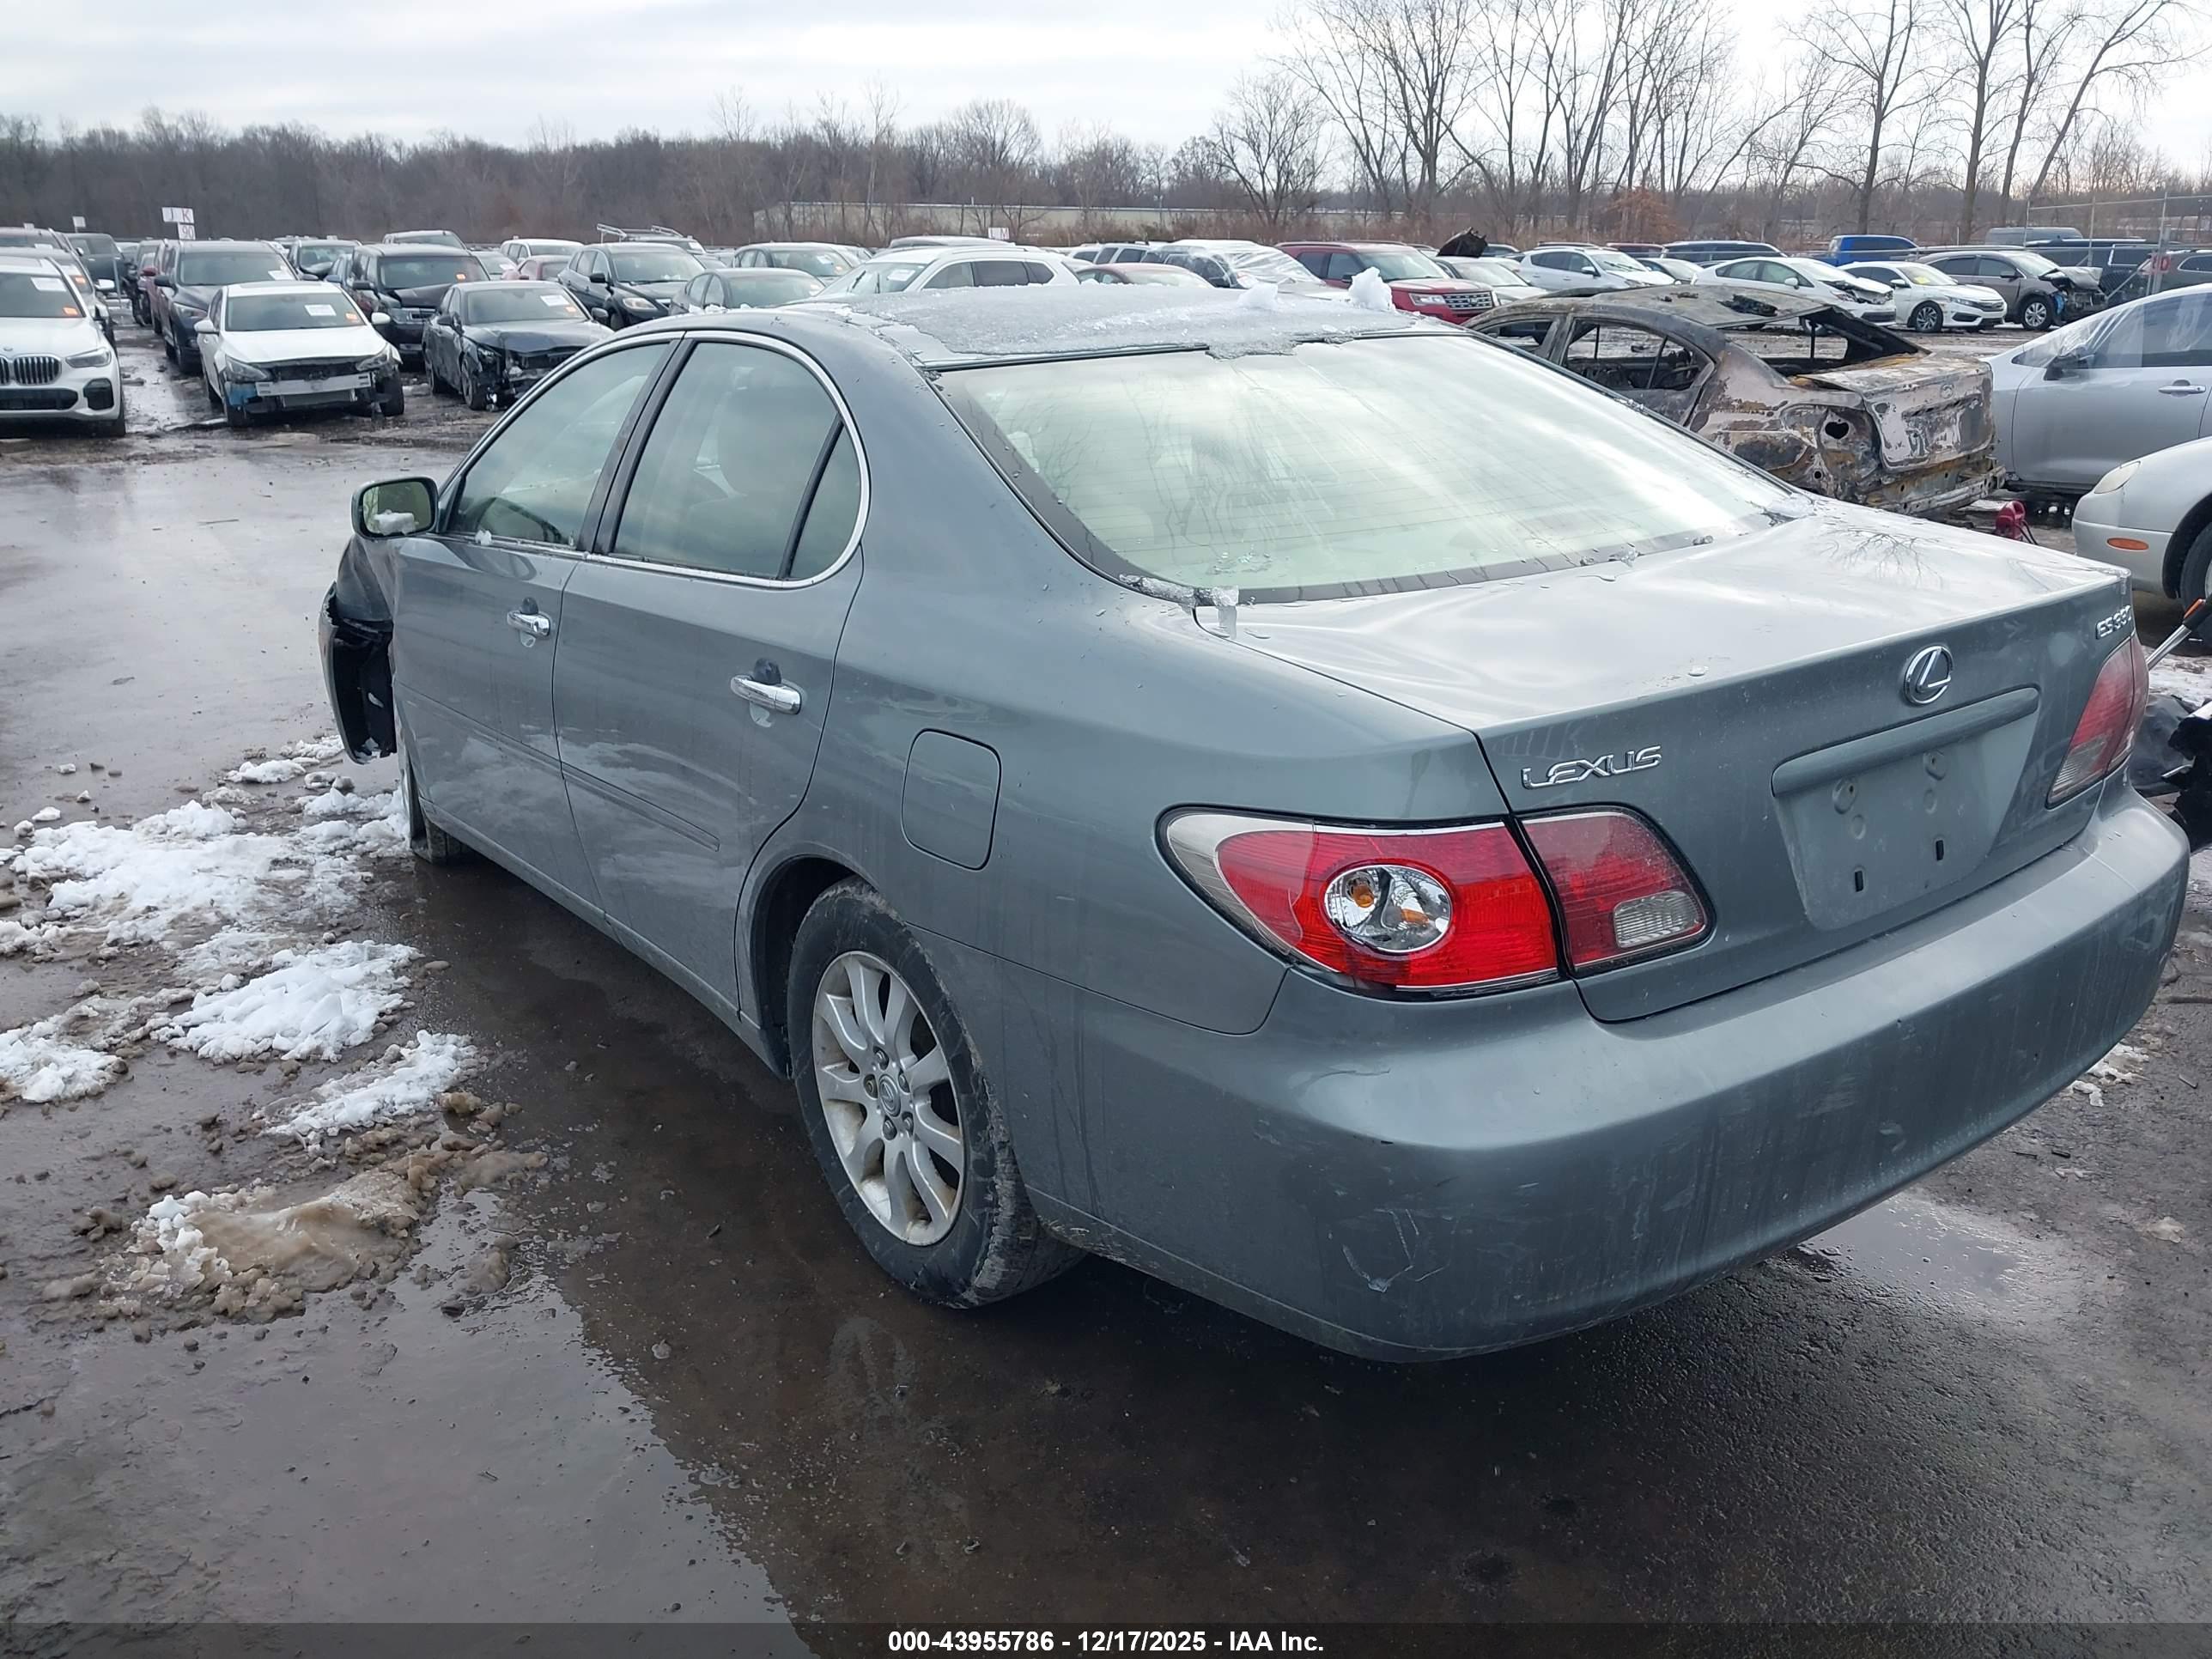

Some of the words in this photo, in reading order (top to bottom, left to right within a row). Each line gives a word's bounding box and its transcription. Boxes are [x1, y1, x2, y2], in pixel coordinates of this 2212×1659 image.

[181, 209, 191, 222] K
[182, 225, 194, 239] 90
[1522, 744, 1662, 789] LEXUS
